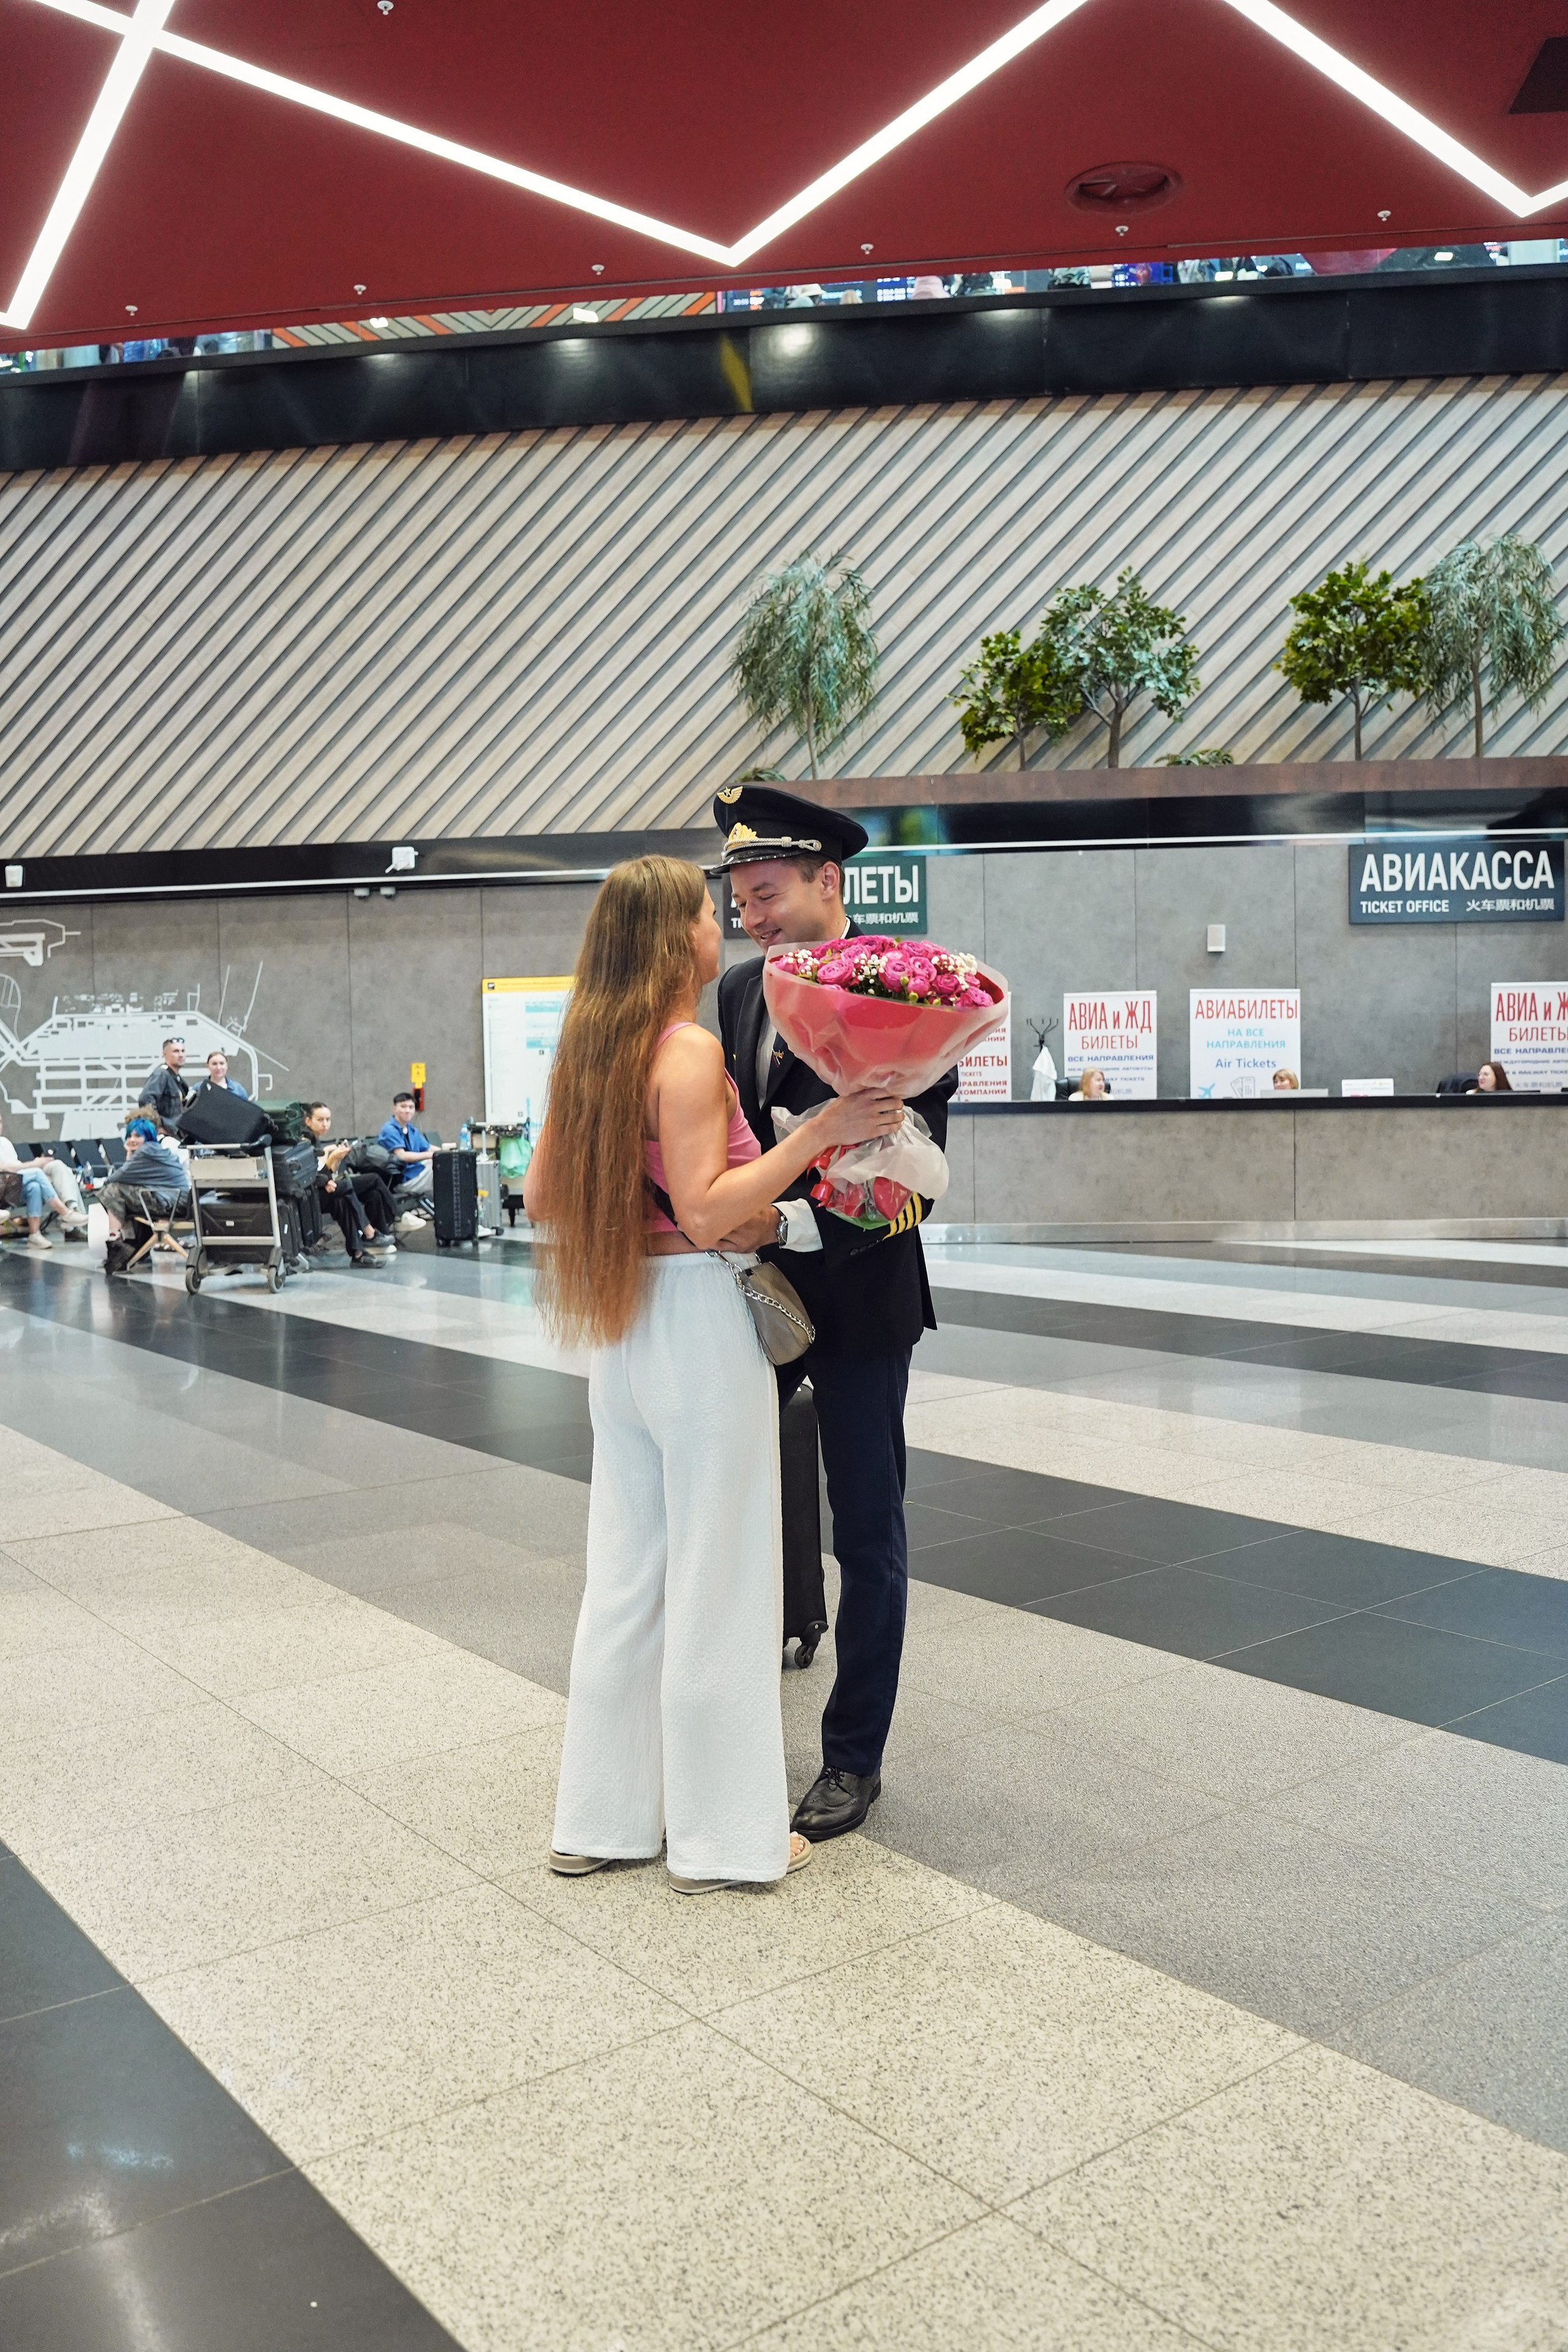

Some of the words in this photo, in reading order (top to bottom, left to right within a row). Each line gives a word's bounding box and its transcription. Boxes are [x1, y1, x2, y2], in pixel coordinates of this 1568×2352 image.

[1360, 850, 1555, 892] АВИАКАССА
[843, 865, 919, 905] ЛЕТЫ
[1360, 900, 1403, 914] TICKET
[1406, 900, 1449, 913] OFFICE
[847, 911, 919, 925] 车票和机票
[1196, 1000, 1297, 1019] АВИАБИЛЕТЫ
[1496, 992, 1538, 1021] АВИА
[1557, 992, 1568, 1020] Ж
[1069, 1002, 1107, 1030] АВИА
[1125, 1001, 1152, 1033] ЖД
[1082, 1035, 1137, 1049] БИЛЕТЫ
[1509, 1027, 1568, 1041] БИЛЕТЫ
[1216, 1058, 1232, 1068] Air
[1236, 1058, 1276, 1068] Tickets
